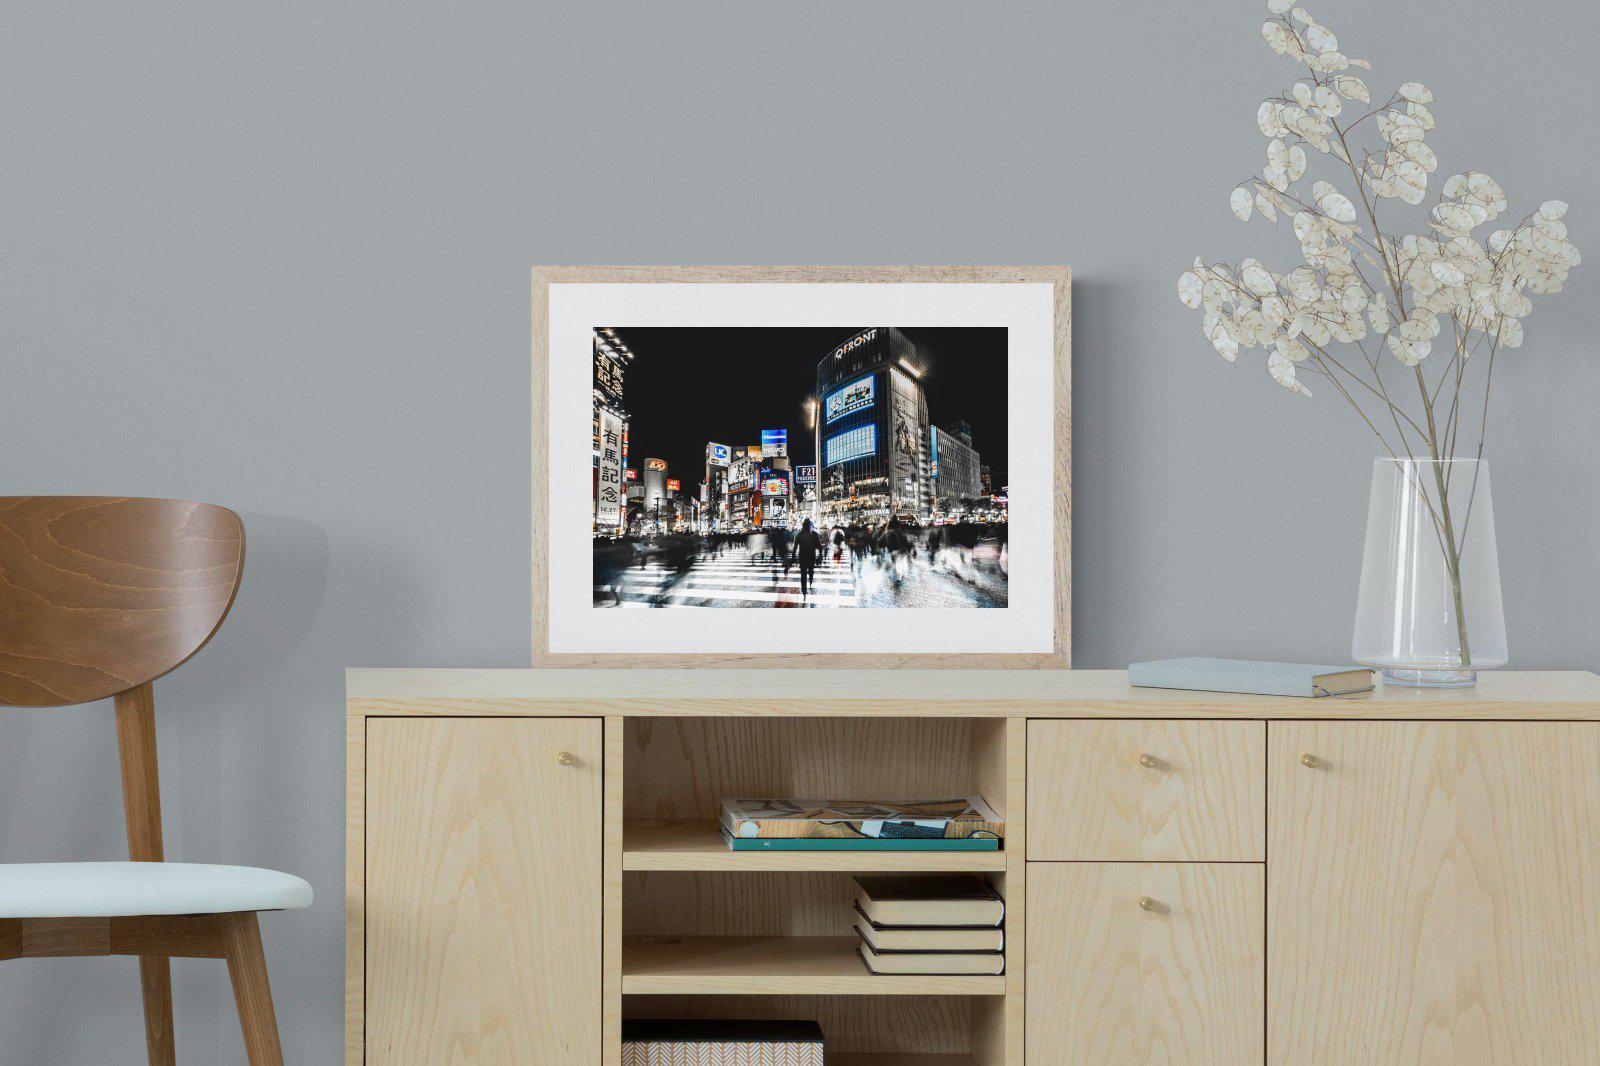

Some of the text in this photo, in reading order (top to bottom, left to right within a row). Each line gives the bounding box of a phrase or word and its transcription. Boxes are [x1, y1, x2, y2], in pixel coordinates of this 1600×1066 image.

[835, 329, 877, 359] QFRONT
[602, 429, 619, 504] 有馬記念
[802, 467, 815, 476] F21
